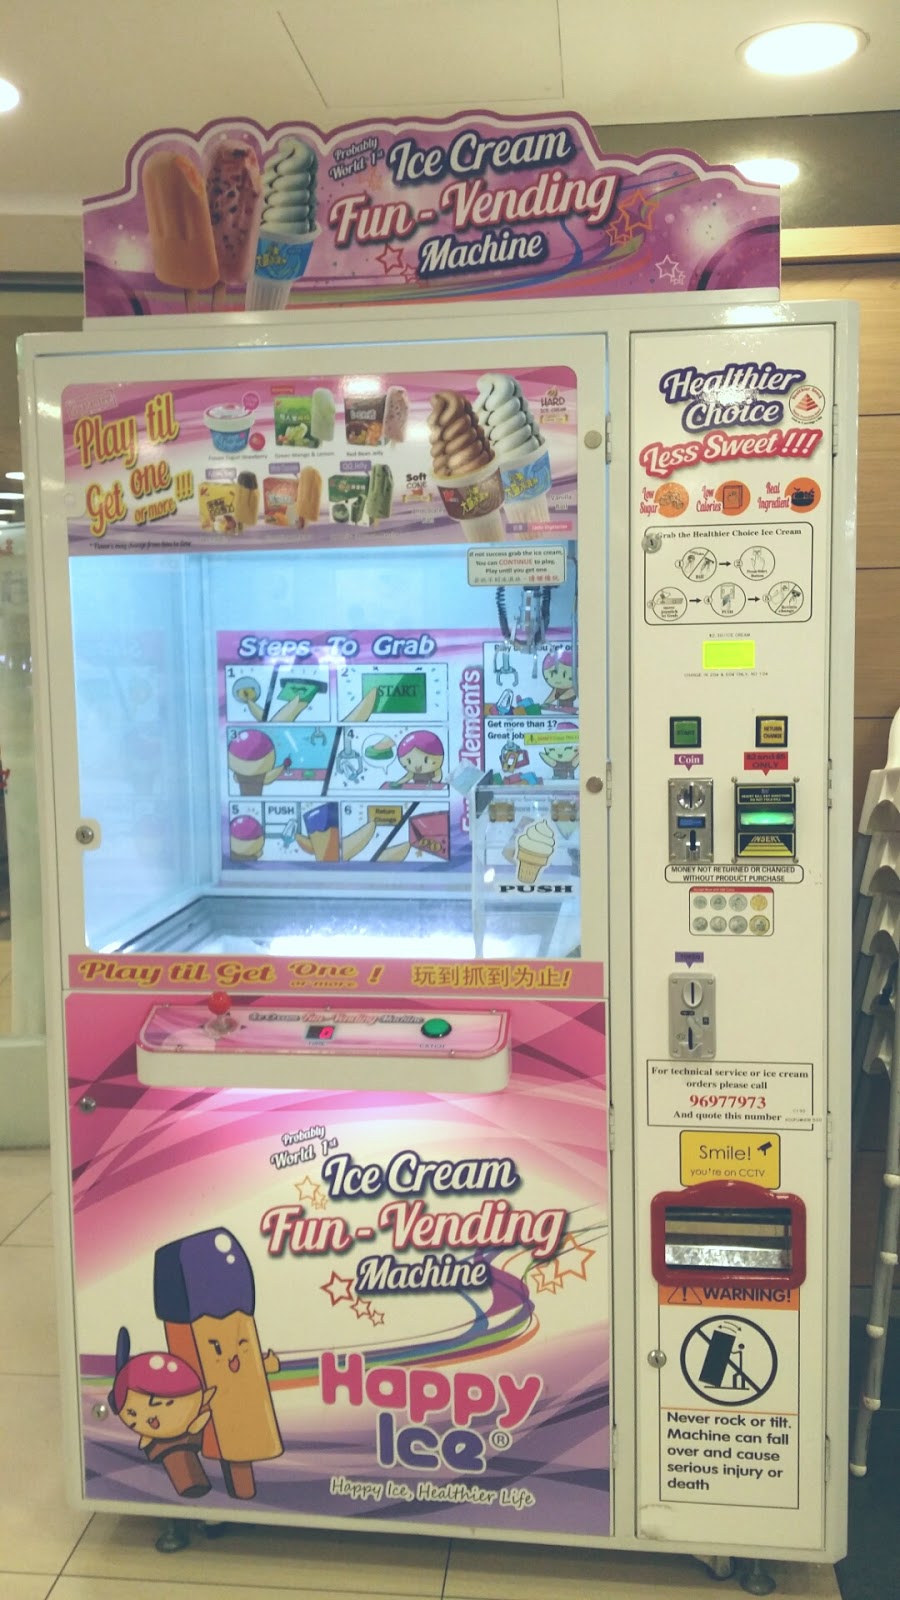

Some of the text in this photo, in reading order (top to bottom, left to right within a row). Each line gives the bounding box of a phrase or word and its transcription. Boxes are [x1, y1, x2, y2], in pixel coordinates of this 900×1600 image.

[333, 136, 379, 161] Probably
[389, 129, 571, 181] Ice Cream
[329, 157, 367, 181] World
[330, 171, 619, 243] Fun Vending
[420, 232, 543, 273] Machine
[662, 365, 802, 400] Healthier
[684, 400, 781, 431] Choice
[73, 415, 138, 468] Play
[145, 392, 180, 444] til
[643, 446, 700, 475] Less
[703, 433, 779, 460] Sweet
[405, 472, 427, 482] Soft
[641, 486, 655, 500] Low
[701, 485, 715, 500] Low
[765, 481, 780, 495] Real
[86, 483, 127, 536] Get
[130, 461, 171, 499] one
[695, 501, 722, 513] Calories
[757, 497, 791, 512] Ingredient
[134, 499, 177, 524] or more
[639, 502, 658, 517] Sugar
[678, 531, 691, 539] the
[775, 528, 802, 536] Cream
[238, 633, 437, 658] Steps To Grab
[378, 685, 419, 698] START
[487, 720, 502, 728] Get
[526, 720, 545, 728] than
[487, 731, 510, 740] Great
[678, 755, 700, 764] Coin
[231, 805, 239, 815] 5
[268, 806, 295, 815] PUSH
[344, 805, 352, 815] 6
[751, 835, 781, 843] INSERT
[499, 885, 573, 893] PUSH
[79, 961, 162, 986] Play
[168, 962, 211, 984] til
[215, 962, 277, 987] Get
[288, 961, 357, 978] One
[313, 980, 357, 988] more
[651, 1066, 669, 1075] For
[671, 1067, 712, 1076] technical
[715, 1069, 748, 1077] service
[763, 1069, 776, 1077] ice
[779, 1070, 808, 1078] cream
[686, 1080, 767, 1090] orders please call
[689, 1094, 767, 1109] 96977973
[673, 1111, 693, 1119] And
[695, 1111, 722, 1121] quote
[724, 1112, 742, 1120] this
[744, 1113, 782, 1121] number
[281, 1125, 326, 1147] Probably
[270, 1144, 316, 1170] World
[698, 1144, 751, 1161] Smile!
[323, 1152, 516, 1196] Ice Cream
[690, 1168, 766, 1178] you're on CCTV
[261, 1200, 566, 1258] Fun Vending
[358, 1255, 487, 1292] Machine
[703, 1286, 792, 1303] WARNING!
[320, 1351, 542, 1429] Happy
[667, 1412, 792, 1429] Never rock or tilt.
[378, 1411, 486, 1471] Ice
[667, 1428, 789, 1445] Machine can fall
[667, 1447, 780, 1462] over and cause
[667, 1462, 783, 1480] serious injury or
[667, 1478, 710, 1491] death
[331, 1478, 535, 1510] Happy Ice, Healthier Life
